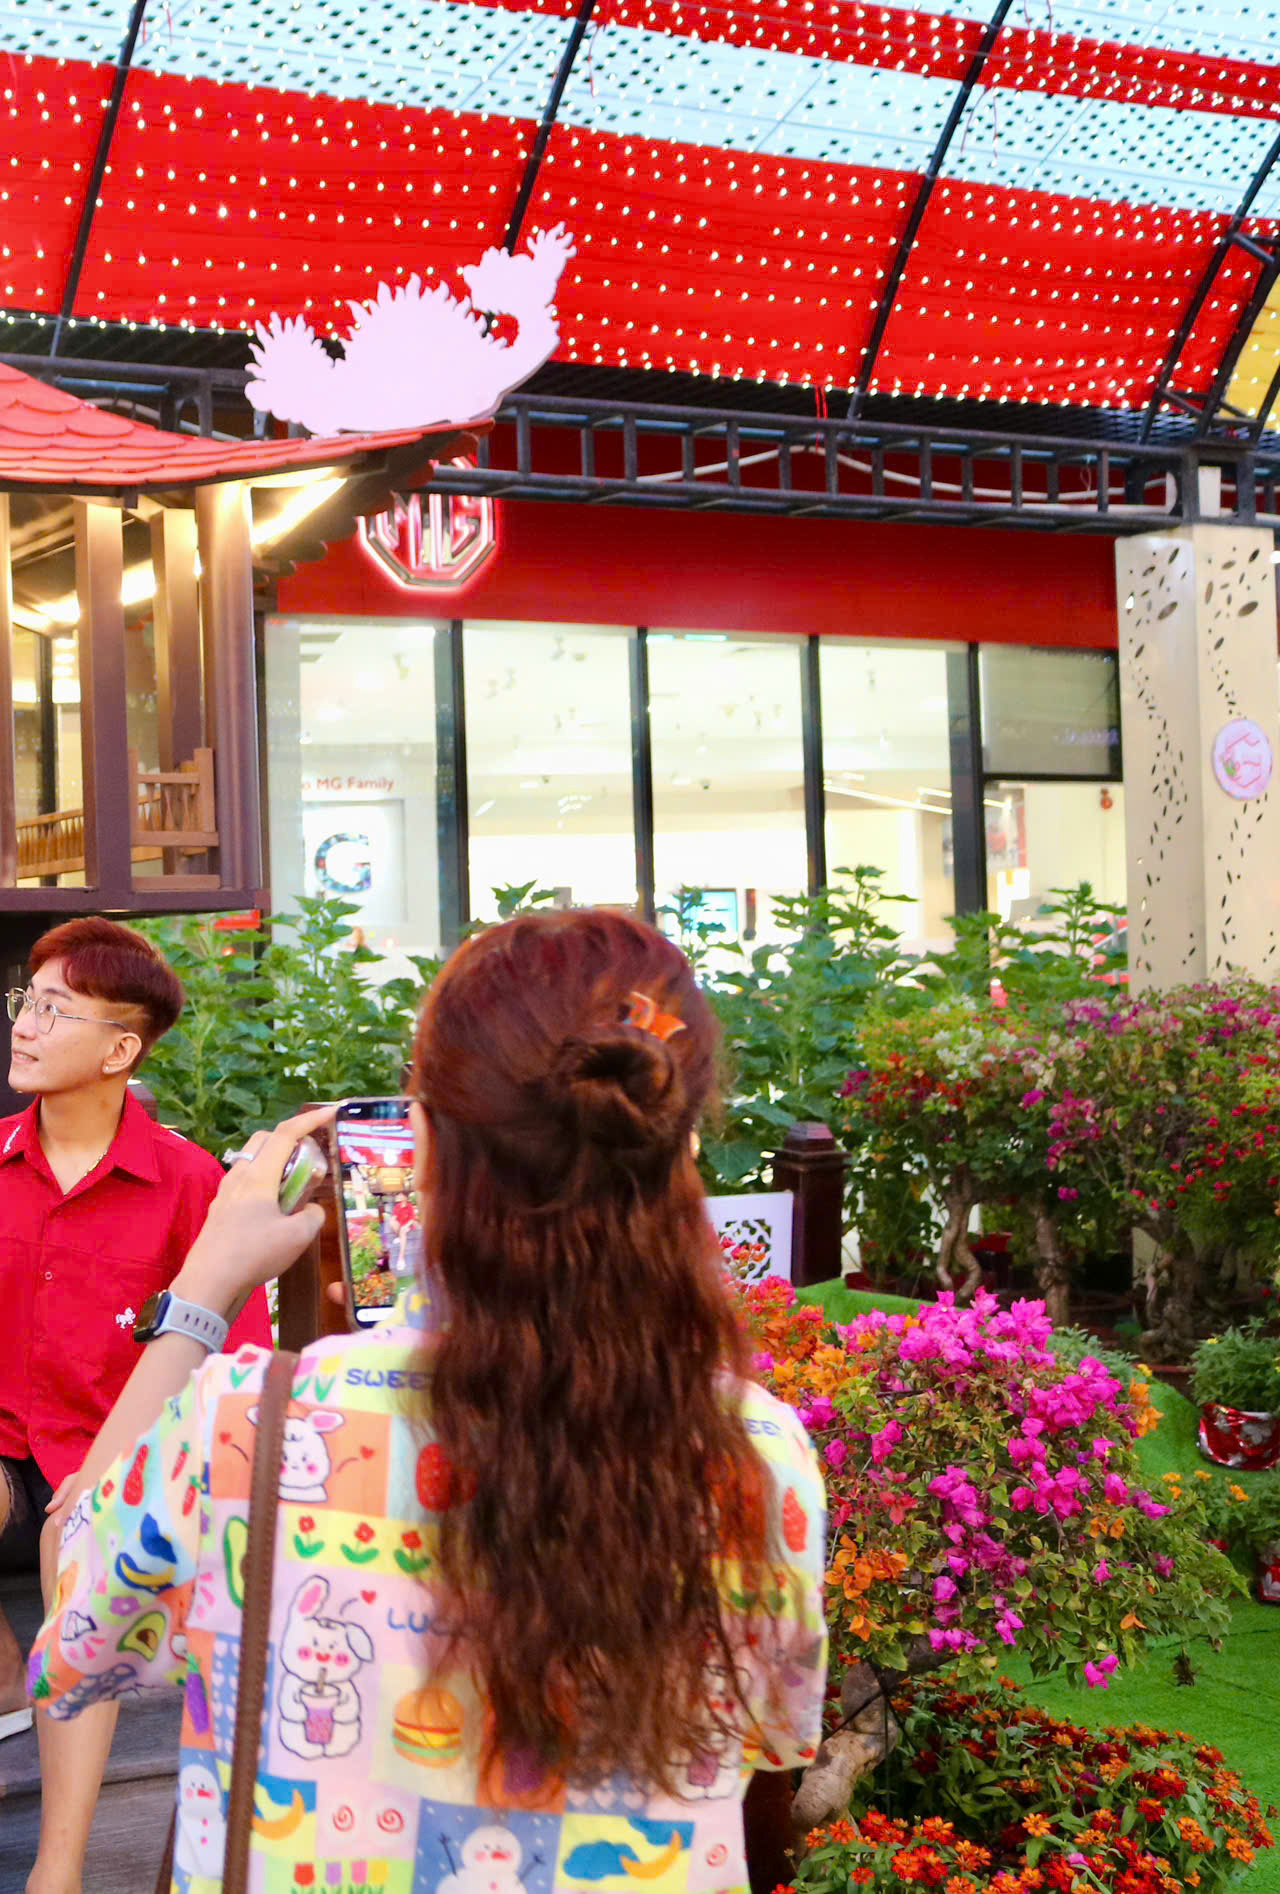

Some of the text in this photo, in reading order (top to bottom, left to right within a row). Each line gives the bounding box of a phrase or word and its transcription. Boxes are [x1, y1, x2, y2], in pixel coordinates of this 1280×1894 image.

[316, 777, 343, 790] MG
[347, 776, 395, 792] Family
[314, 832, 372, 893] G
[345, 1368, 428, 1392] SWEE
